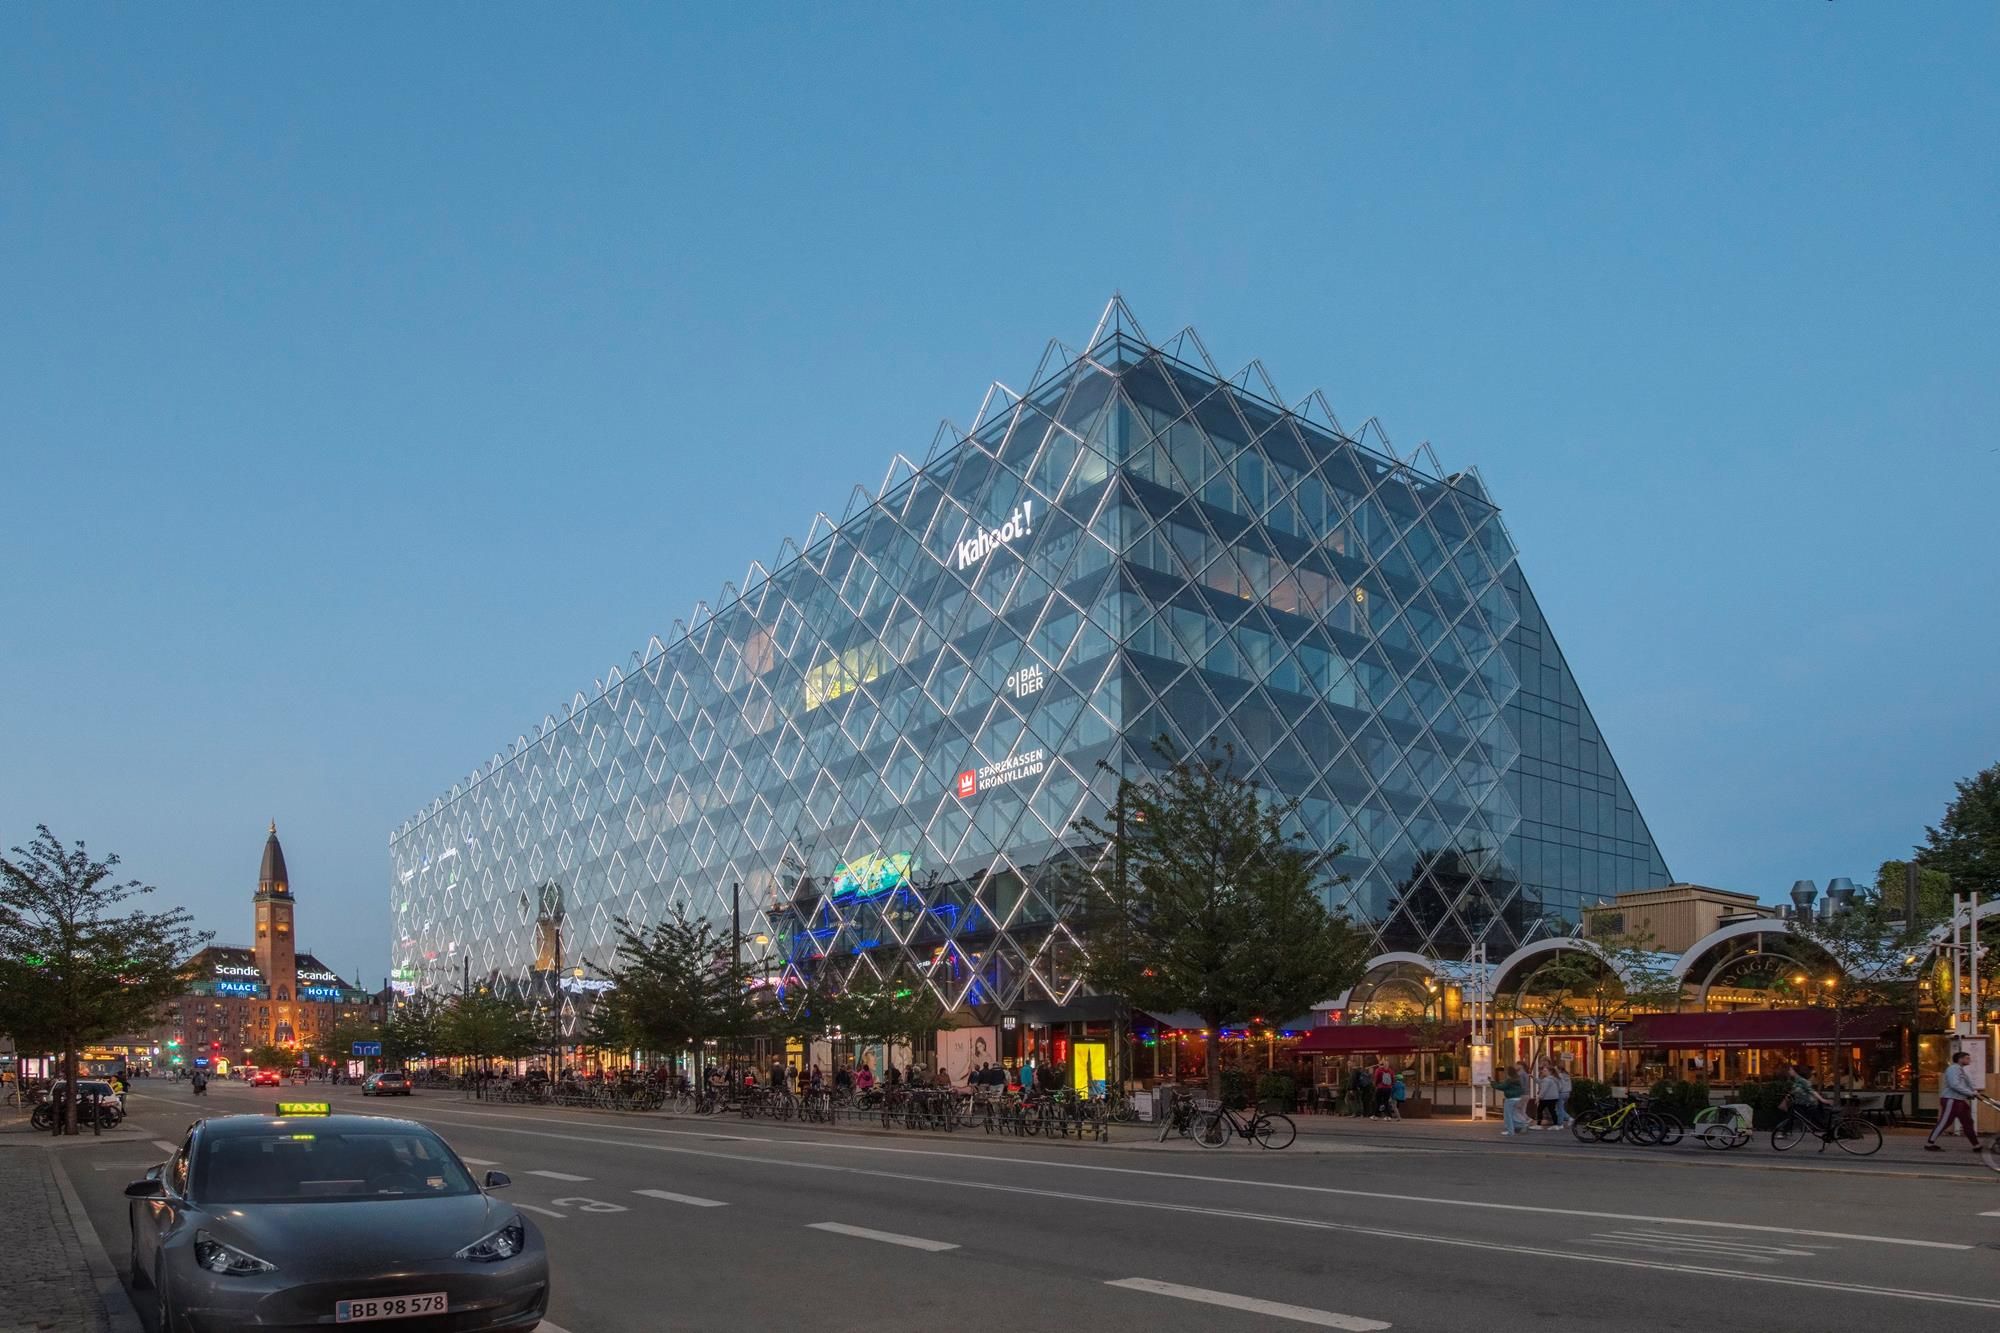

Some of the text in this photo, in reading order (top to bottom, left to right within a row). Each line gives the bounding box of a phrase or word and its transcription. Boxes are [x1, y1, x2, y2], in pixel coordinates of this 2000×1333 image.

[1021, 664, 1043, 682] BAL
[1021, 677, 1043, 696] DER
[979, 749, 1043, 778] SPAREKASSEN
[979, 762, 1043, 790] KRONJYLLAND
[215, 964, 260, 977] Scandic
[297, 970, 337, 981] Scandic
[221, 983, 257, 992] PALACE
[308, 988, 340, 996] HOTEL
[280, 1103, 327, 1113] TAXI
[352, 1296, 444, 1318] BB 98 578
